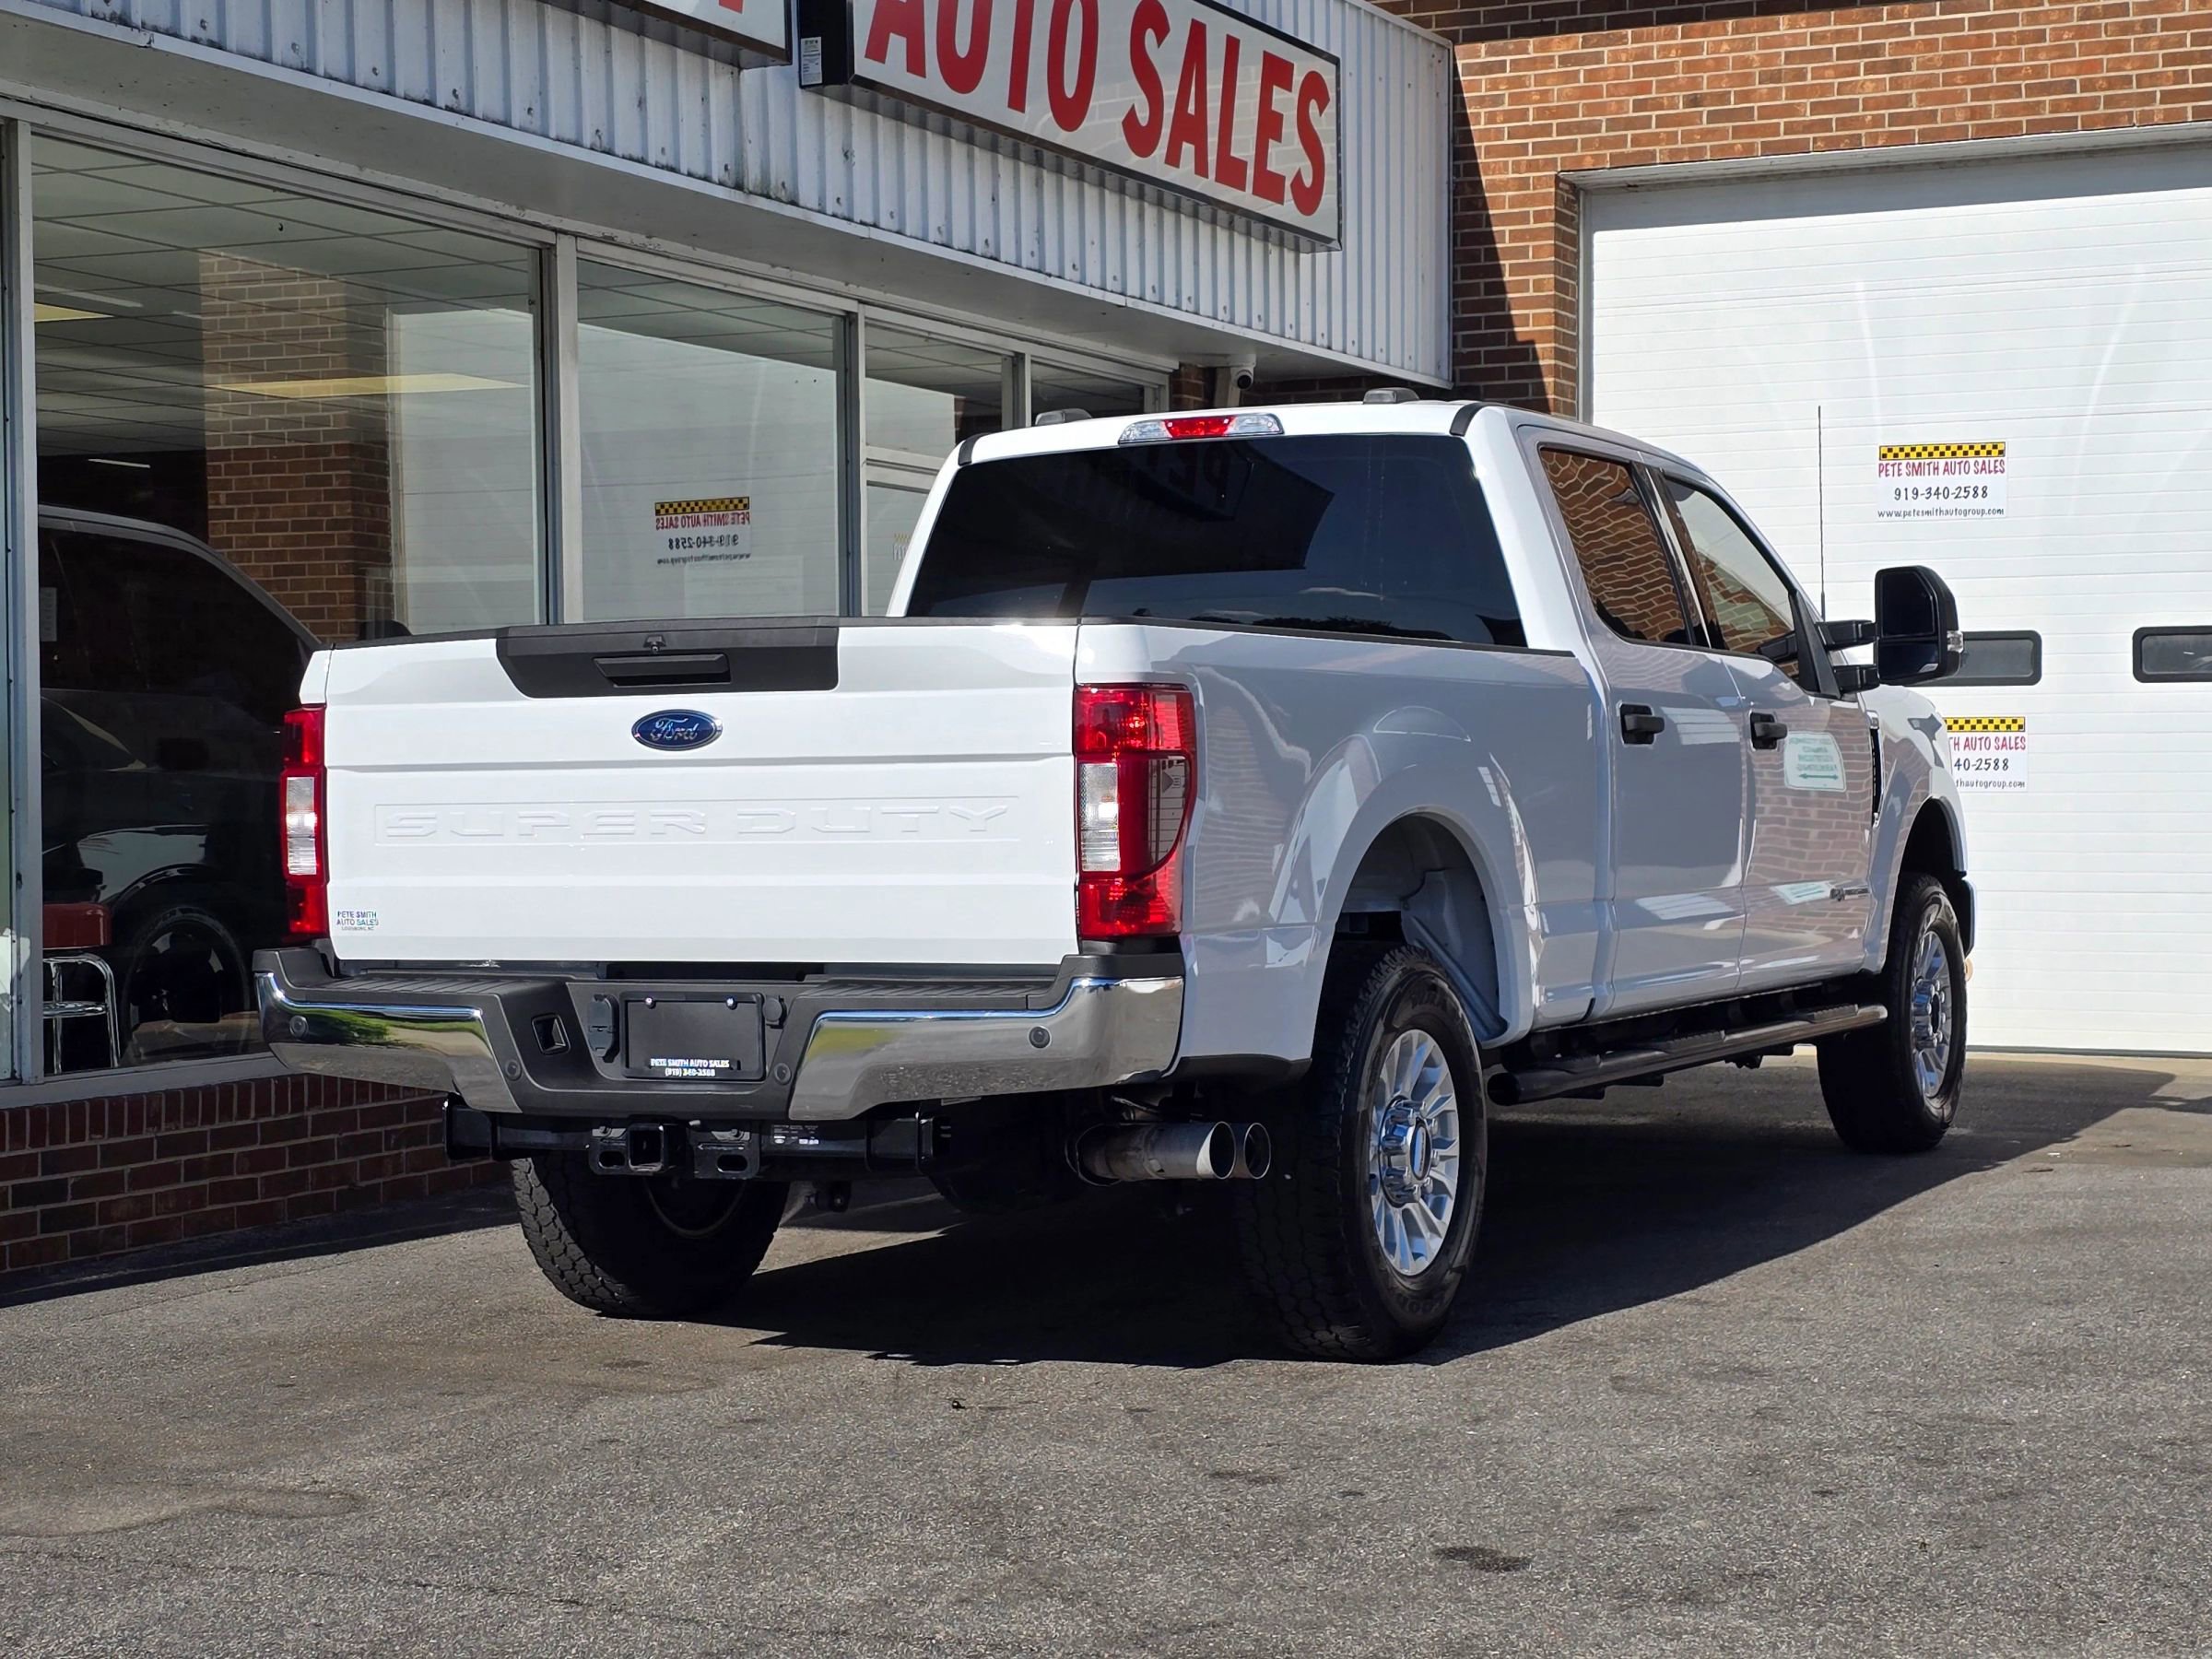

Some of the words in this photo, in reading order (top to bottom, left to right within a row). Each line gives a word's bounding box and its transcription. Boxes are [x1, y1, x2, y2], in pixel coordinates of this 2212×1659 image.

[1122, 0, 1331, 218] SALES
[1878, 462, 1902, 477] PETE
[1905, 461, 1939, 477] SMITH
[1942, 460, 1971, 476] AUTO
[1973, 459, 2006, 475] SALES
[1894, 486, 1988, 500] 919-340-2588
[1877, 507, 2005, 519] www.petesmithautogroup.com
[650, 717, 700, 741] Ford
[1963, 736, 1992, 751] AUTO
[1994, 735, 2026, 751] SALES
[1954, 758, 2009, 771] 40-2588
[1956, 779, 2026, 790] thautogroup.com
[386, 810, 706, 837] SUPER
[737, 805, 1008, 833] DUTY
[689, 1059, 709, 1067] AUTO
